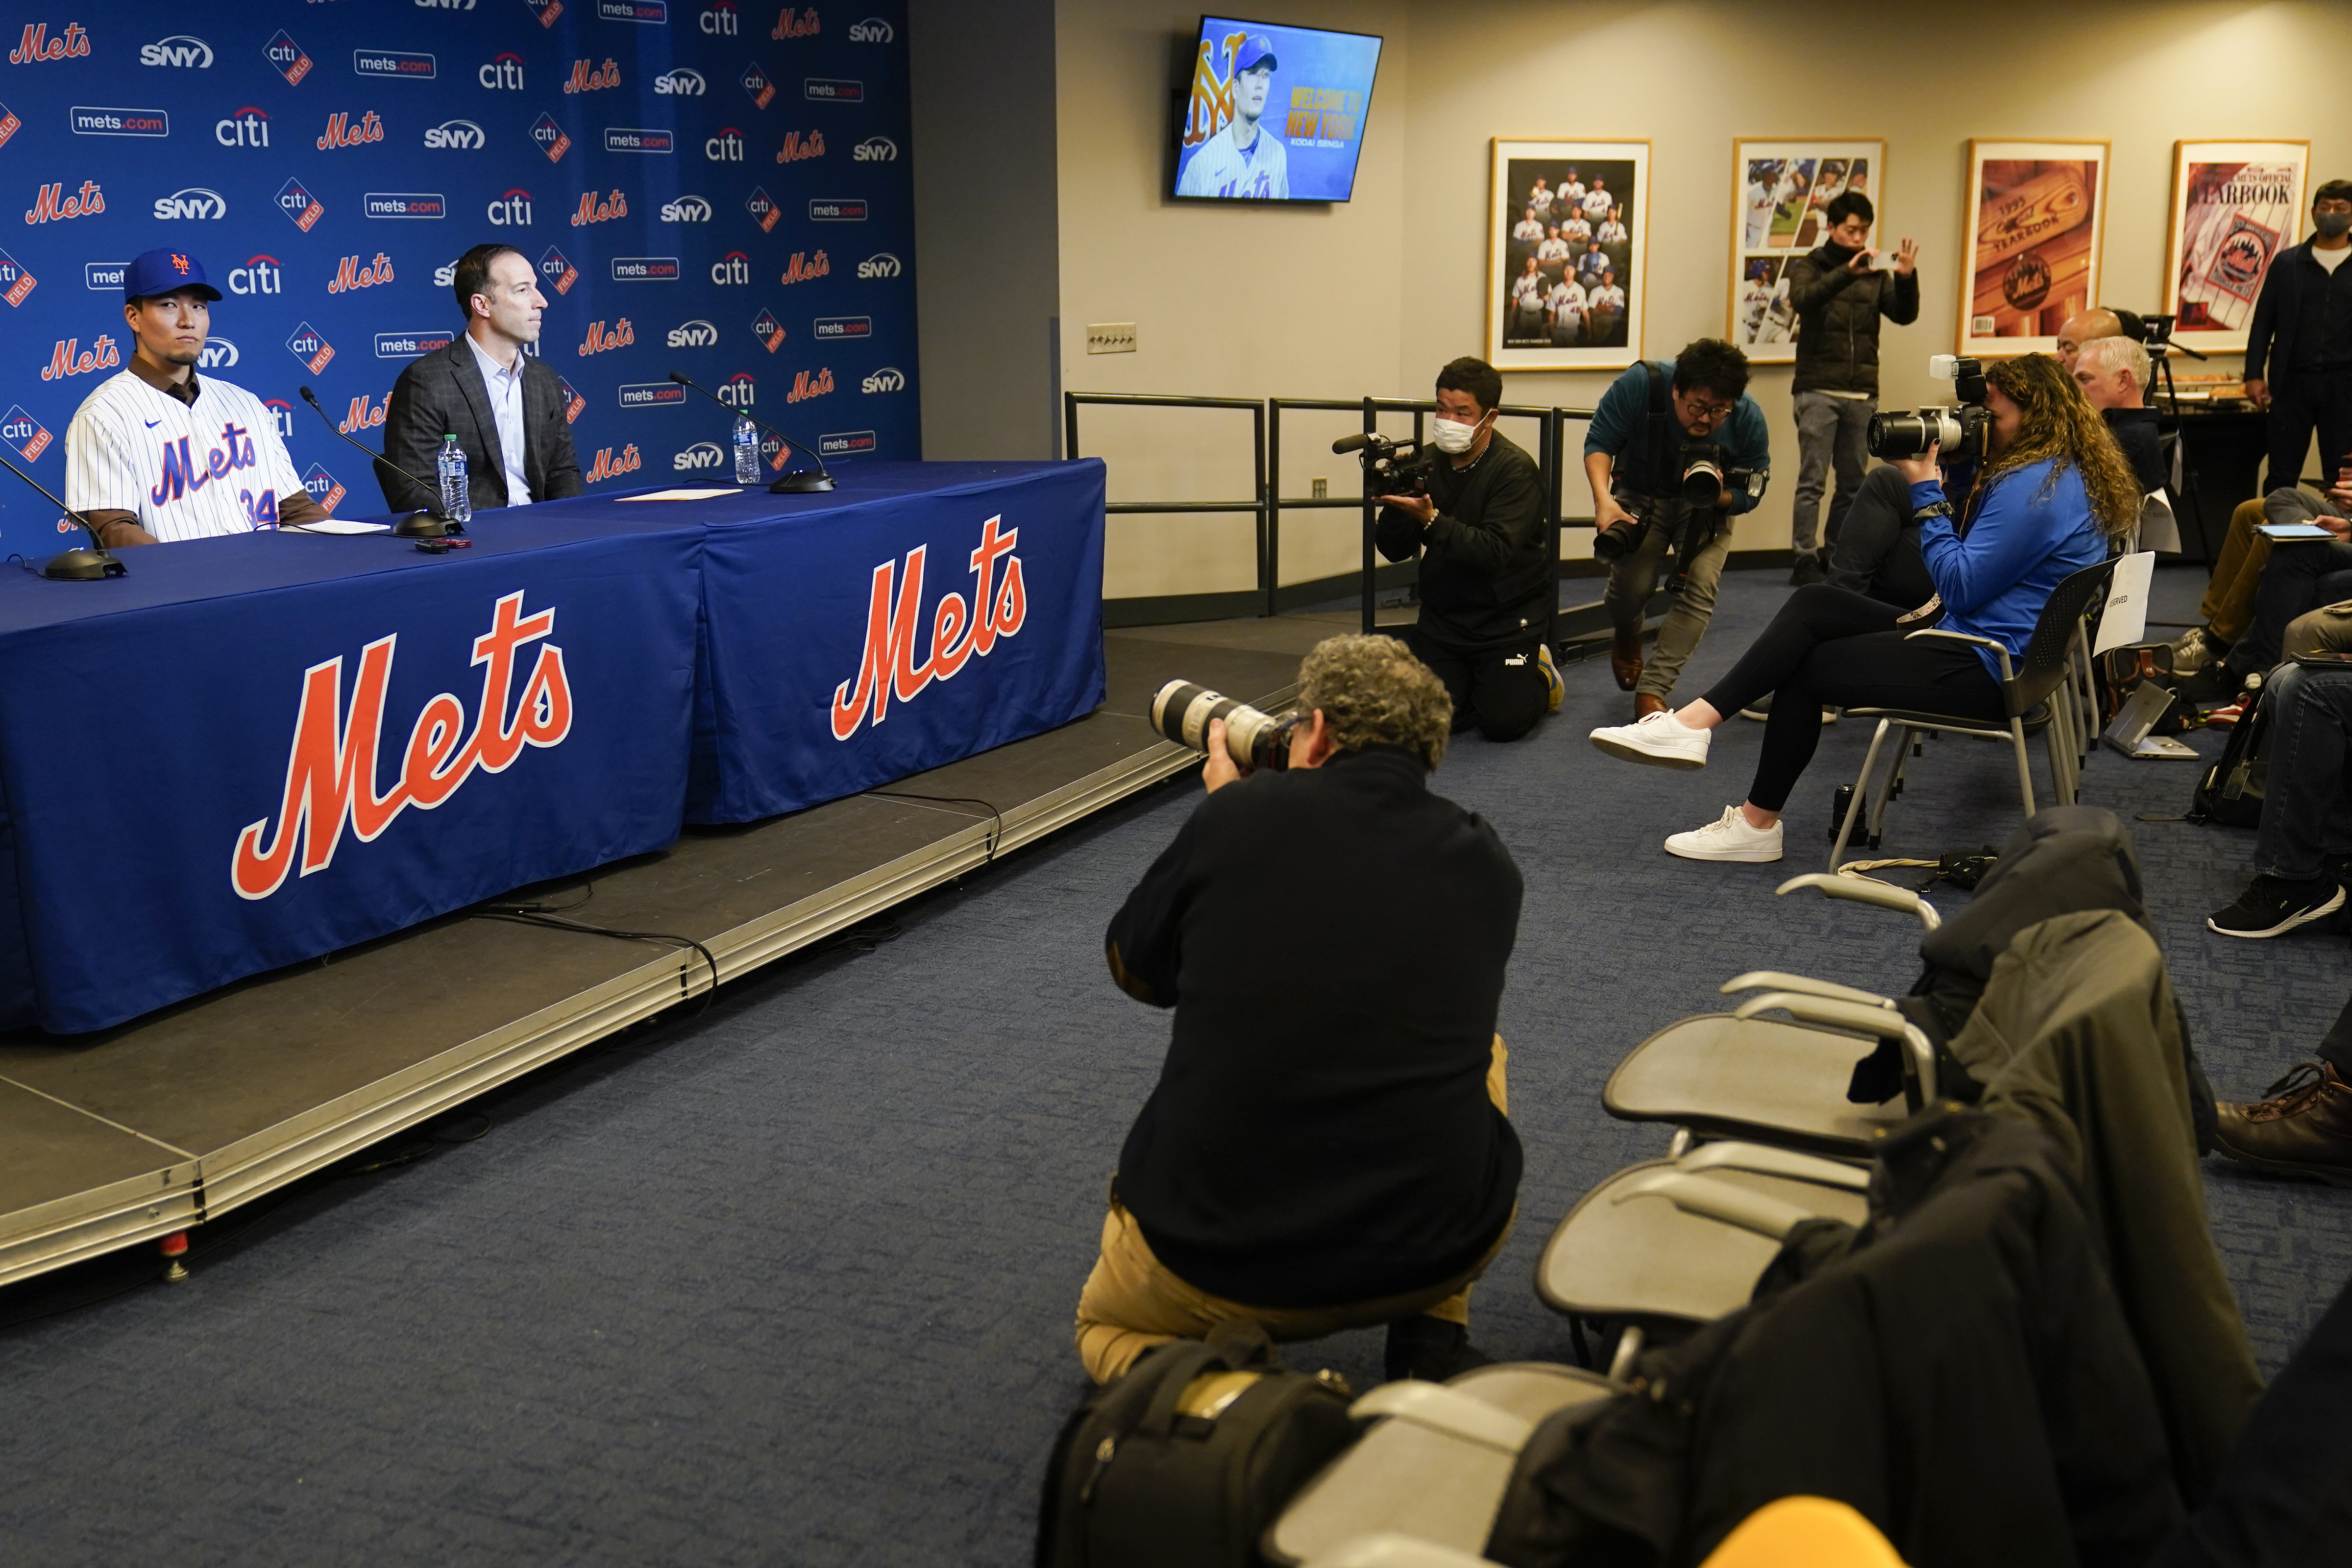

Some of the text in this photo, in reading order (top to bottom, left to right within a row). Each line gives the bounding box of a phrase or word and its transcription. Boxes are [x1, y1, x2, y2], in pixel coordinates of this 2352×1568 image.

[542, 2, 559, 24] FIELD
[603, 4, 662, 17] mets.com
[700, 7, 737, 35] citi
[772, 8, 820, 40] Mets
[849, 24, 886, 43] SNY
[10, 23, 90, 64] Mets
[270, 46, 294, 61] citi
[140, 44, 202, 67] SNY
[361, 57, 430, 72] mets.com
[287, 58, 309, 82] FIELD
[479, 60, 523, 90] citi
[564, 58, 620, 94] Mets
[654, 76, 699, 95] SNY
[745, 76, 763, 88] citi
[809, 85, 859, 96] mets.com
[757, 86, 773, 108] FIELD
[1291, 86, 1362, 113] WELCOME TO
[78, 115, 162, 129] mets.com
[216, 114, 268, 147] citi
[317, 111, 384, 150] Mets
[535, 126, 555, 140] citi
[1285, 110, 1358, 141] NEW YORK
[424, 128, 475, 148] SNY
[550, 137, 567, 160] FIELD
[611, 135, 668, 147] mets.com
[706, 134, 742, 161] citi
[777, 130, 825, 163] Mets
[853, 144, 890, 161] SNY
[25, 180, 105, 224] Mets
[153, 197, 214, 220] SNY
[282, 193, 306, 208] citi
[371, 200, 440, 212] mets.com
[488, 196, 531, 225] citi
[571, 190, 627, 226] Mets
[751, 199, 768, 212] citi
[814, 205, 863, 216] mets.com
[299, 205, 321, 229] FIELD
[661, 203, 704, 221] SNY
[763, 209, 778, 231] FIELD
[171, 254, 190, 275] NY
[328, 253, 394, 294] Mets
[543, 260, 563, 273] citi
[617, 264, 675, 275] mets.com
[712, 258, 748, 284] citi
[782, 250, 829, 285] Mets
[857, 261, 894, 278] SNY
[229, 262, 280, 294] citi
[558, 270, 575, 292] FIELD
[9, 277, 32, 303] FIELD
[579, 318, 634, 356] Mets
[667, 329, 710, 347] SNY
[756, 321, 773, 333] citi
[819, 323, 867, 334] mets.com
[293, 337, 317, 352] citi
[768, 330, 783, 352] FIELD
[41, 335, 120, 381] Mets
[197, 348, 227, 368] NY
[311, 348, 332, 372] FIELD
[718, 379, 754, 406] citi
[787, 368, 834, 403] Mets
[861, 375, 898, 392] SNY
[624, 390, 681, 401] mets.com
[272, 406, 293, 437] ti
[339, 391, 393, 434] Met
[3, 421, 32, 438] citi
[26, 431, 49, 460] FIELD
[761, 440, 779, 452] citi
[824, 439, 872, 450] mets.com
[151, 422, 256, 507] Mets
[587, 443, 640, 483] Mets
[674, 452, 714, 470] SNY
[774, 448, 788, 468] FIELD
[305, 477, 329, 492] citi
[240, 489, 279, 530] 34
[322, 487, 342, 511] FIELD
[831, 514, 1027, 741] Mets
[231, 589, 572, 900] Mets
